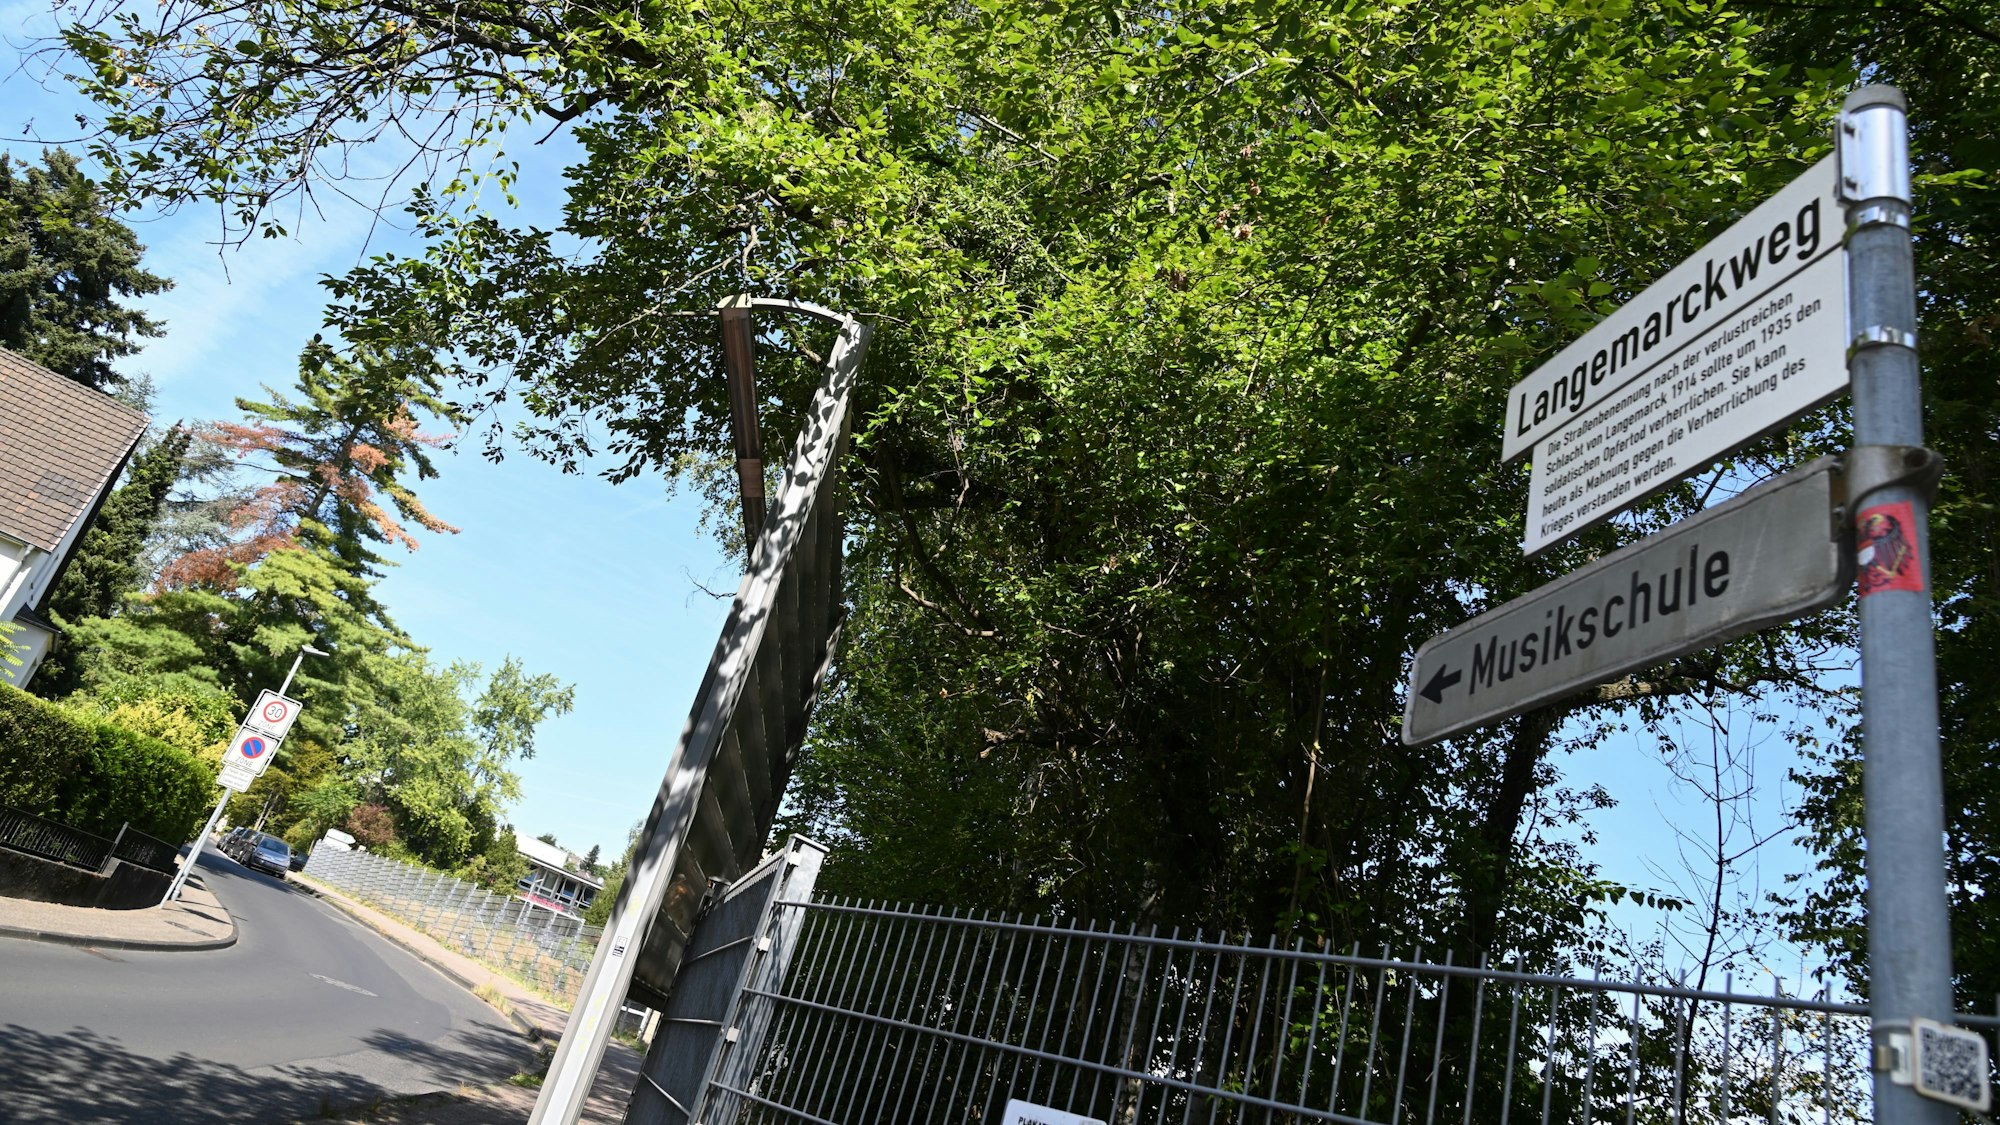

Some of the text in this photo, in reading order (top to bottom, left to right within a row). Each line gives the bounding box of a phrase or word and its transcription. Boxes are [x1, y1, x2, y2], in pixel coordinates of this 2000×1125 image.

[1517, 197, 1819, 437] Langemarckweg
[1546, 298, 1821, 476] Schlacht von Langemarck 1914 sollte um 1935 den
[1547, 292, 1793, 456] Die Straßenbenennung nach der verlustreichen
[1542, 357, 1806, 517] heute als Mahnung gegen die Verherrlichung des
[1544, 344, 1787, 496] soldatischen Opfertod verherrlichen. Sie kann
[1540, 455, 1677, 539] Krieges verstanden werden.
[1468, 543, 1730, 696] Musikschule
[235, 756, 253, 767] ZONE
[258, 720, 276, 731] ZONE
[267, 705, 283, 718] 30
